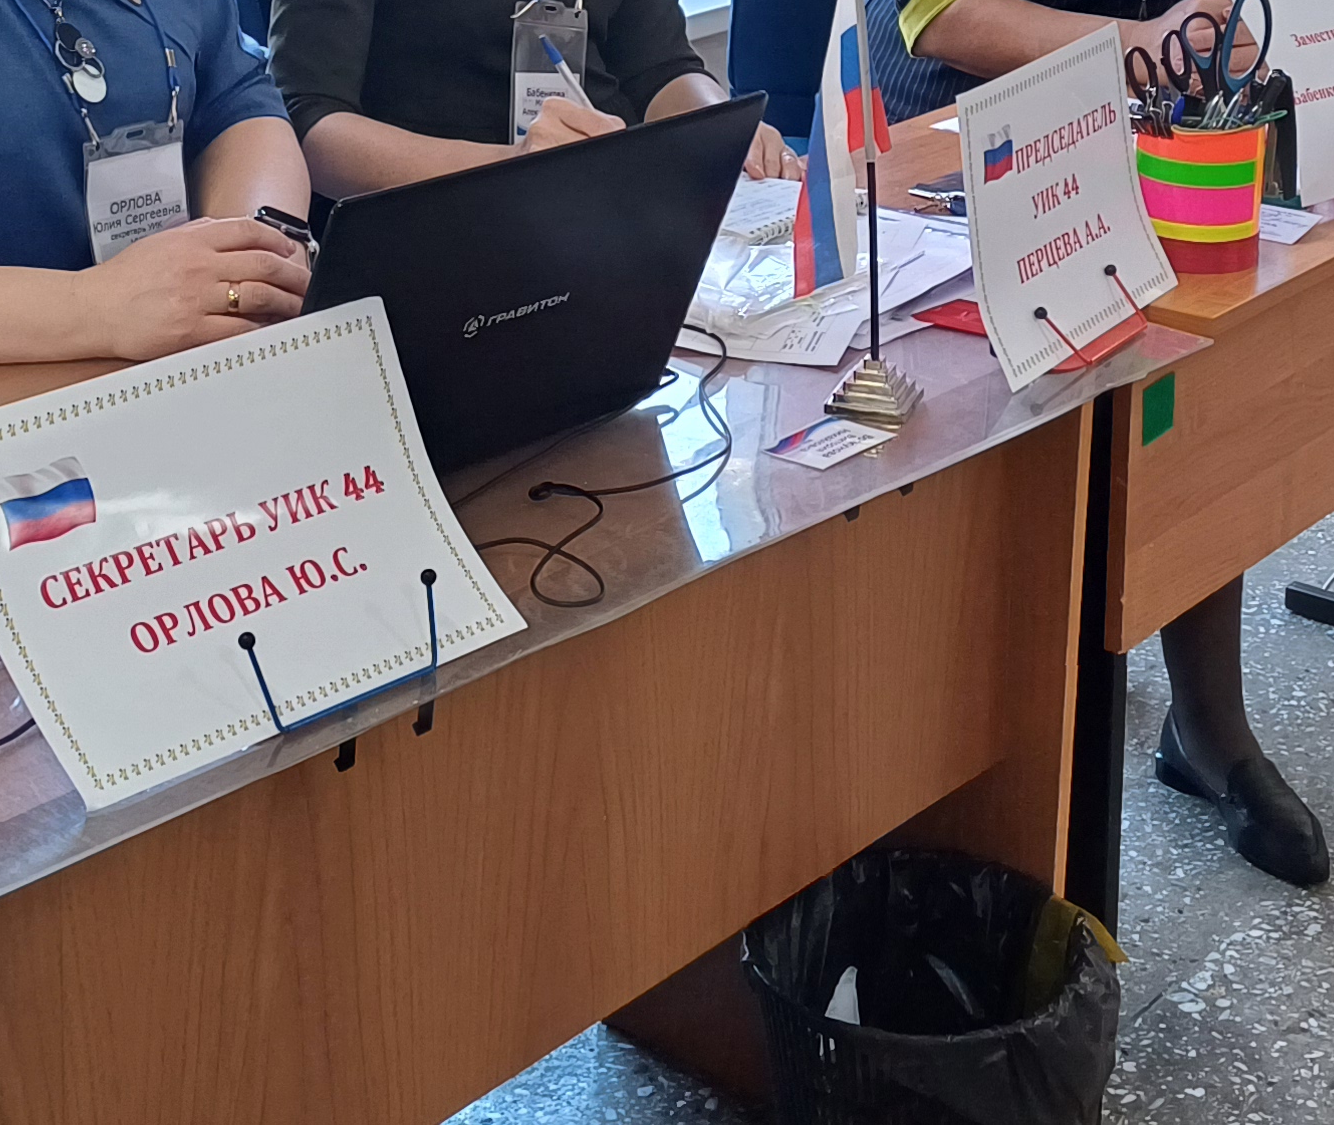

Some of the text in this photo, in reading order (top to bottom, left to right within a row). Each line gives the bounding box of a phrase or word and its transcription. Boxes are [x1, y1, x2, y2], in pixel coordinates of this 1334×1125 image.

[1015, 101, 1117, 174] ПРЕДСЕДАТЕЛЬ
[93, 204, 181, 234] Юлия Сергеевна
[110, 192, 161, 214] ОРЛОВА
[1031, 173, 1080, 219] УИК 44
[1016, 213, 1111, 284] ПЕРЦЕВА А.А.
[486, 292, 570, 326] ГРАВИТОН
[39, 465, 385, 610] СЕКРЕТАРЬ УИК 44
[129, 546, 368, 654] ОРЛОВА Ю.С.
